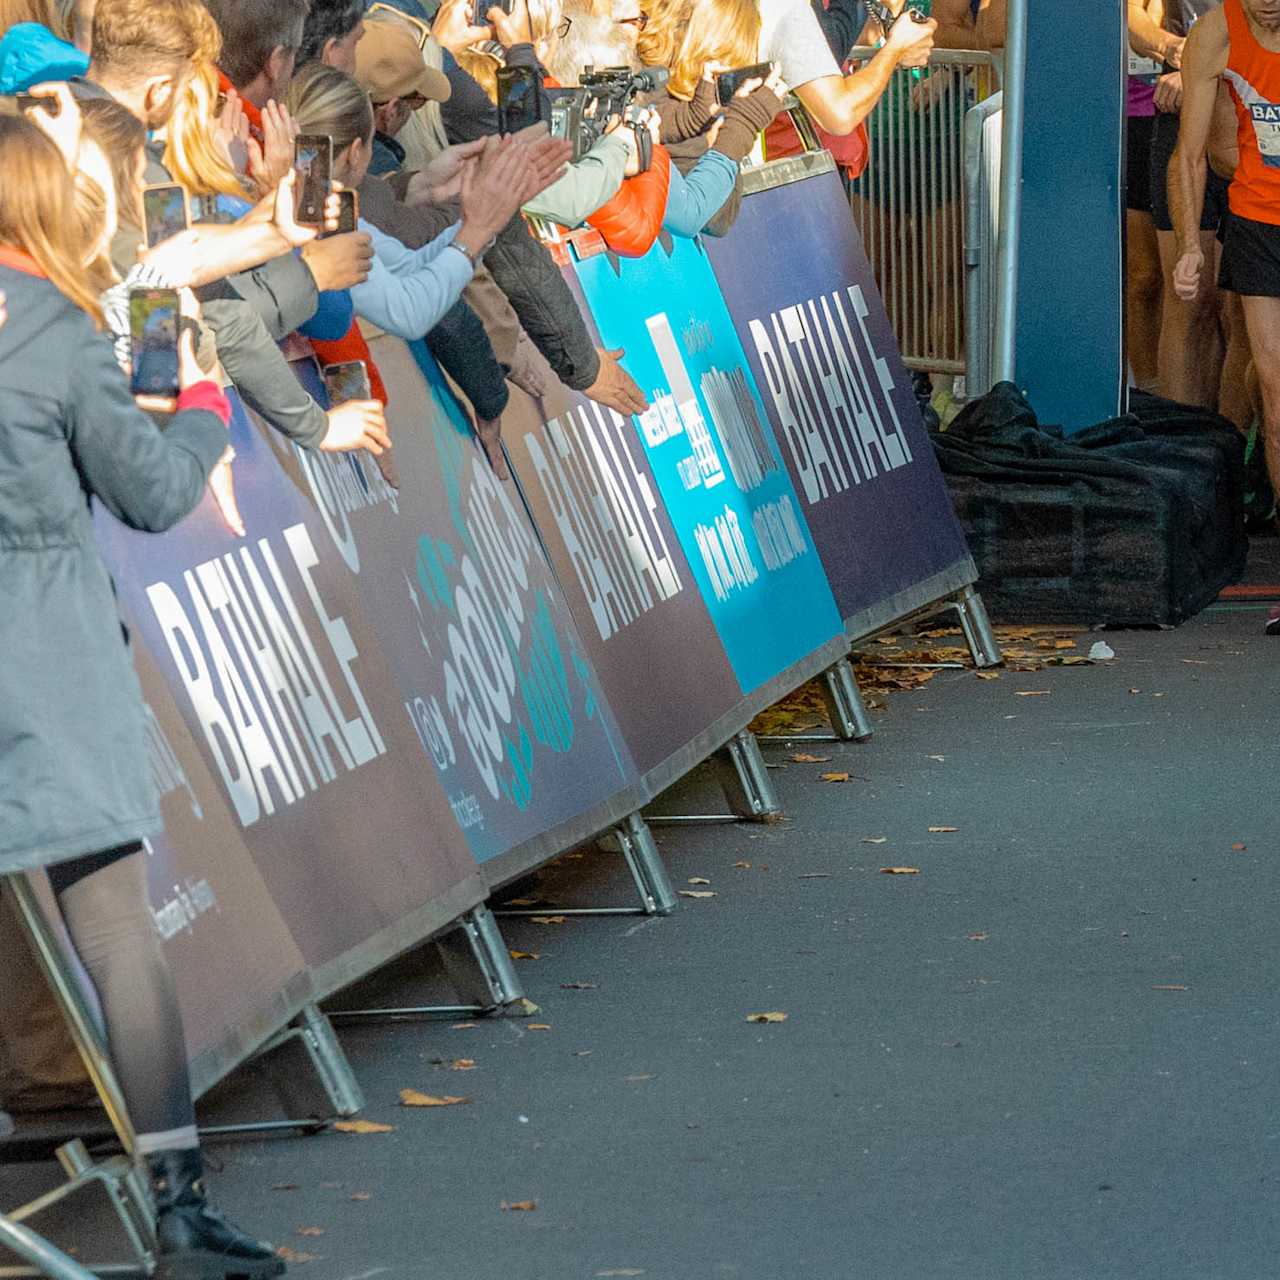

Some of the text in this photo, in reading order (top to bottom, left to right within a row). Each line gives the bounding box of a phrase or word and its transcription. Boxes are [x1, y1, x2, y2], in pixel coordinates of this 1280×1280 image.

[748, 285, 913, 505] BATHALF
[524, 400, 683, 641] BATHALF
[145, 522, 387, 827] BATHALF
